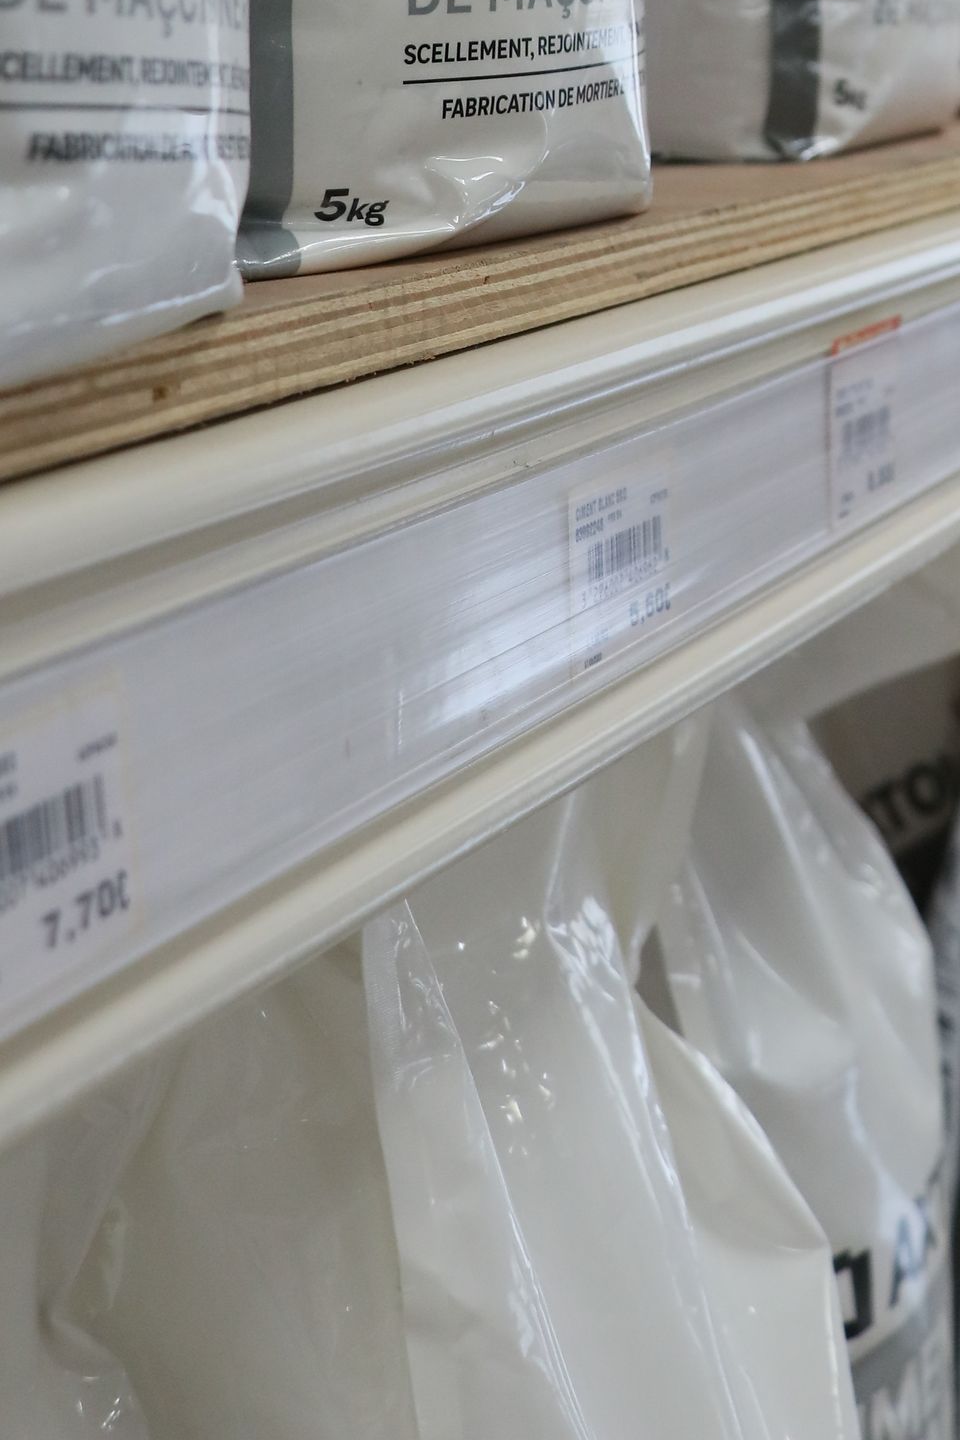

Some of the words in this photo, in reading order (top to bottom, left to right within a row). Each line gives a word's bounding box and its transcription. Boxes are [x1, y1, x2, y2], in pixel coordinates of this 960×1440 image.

[403, 37, 536, 66] SCELLEMENT,
[441, 89, 556, 120] FABRICATION
[558, 86, 575, 109] DE
[313, 188, 390, 227] 5kg
